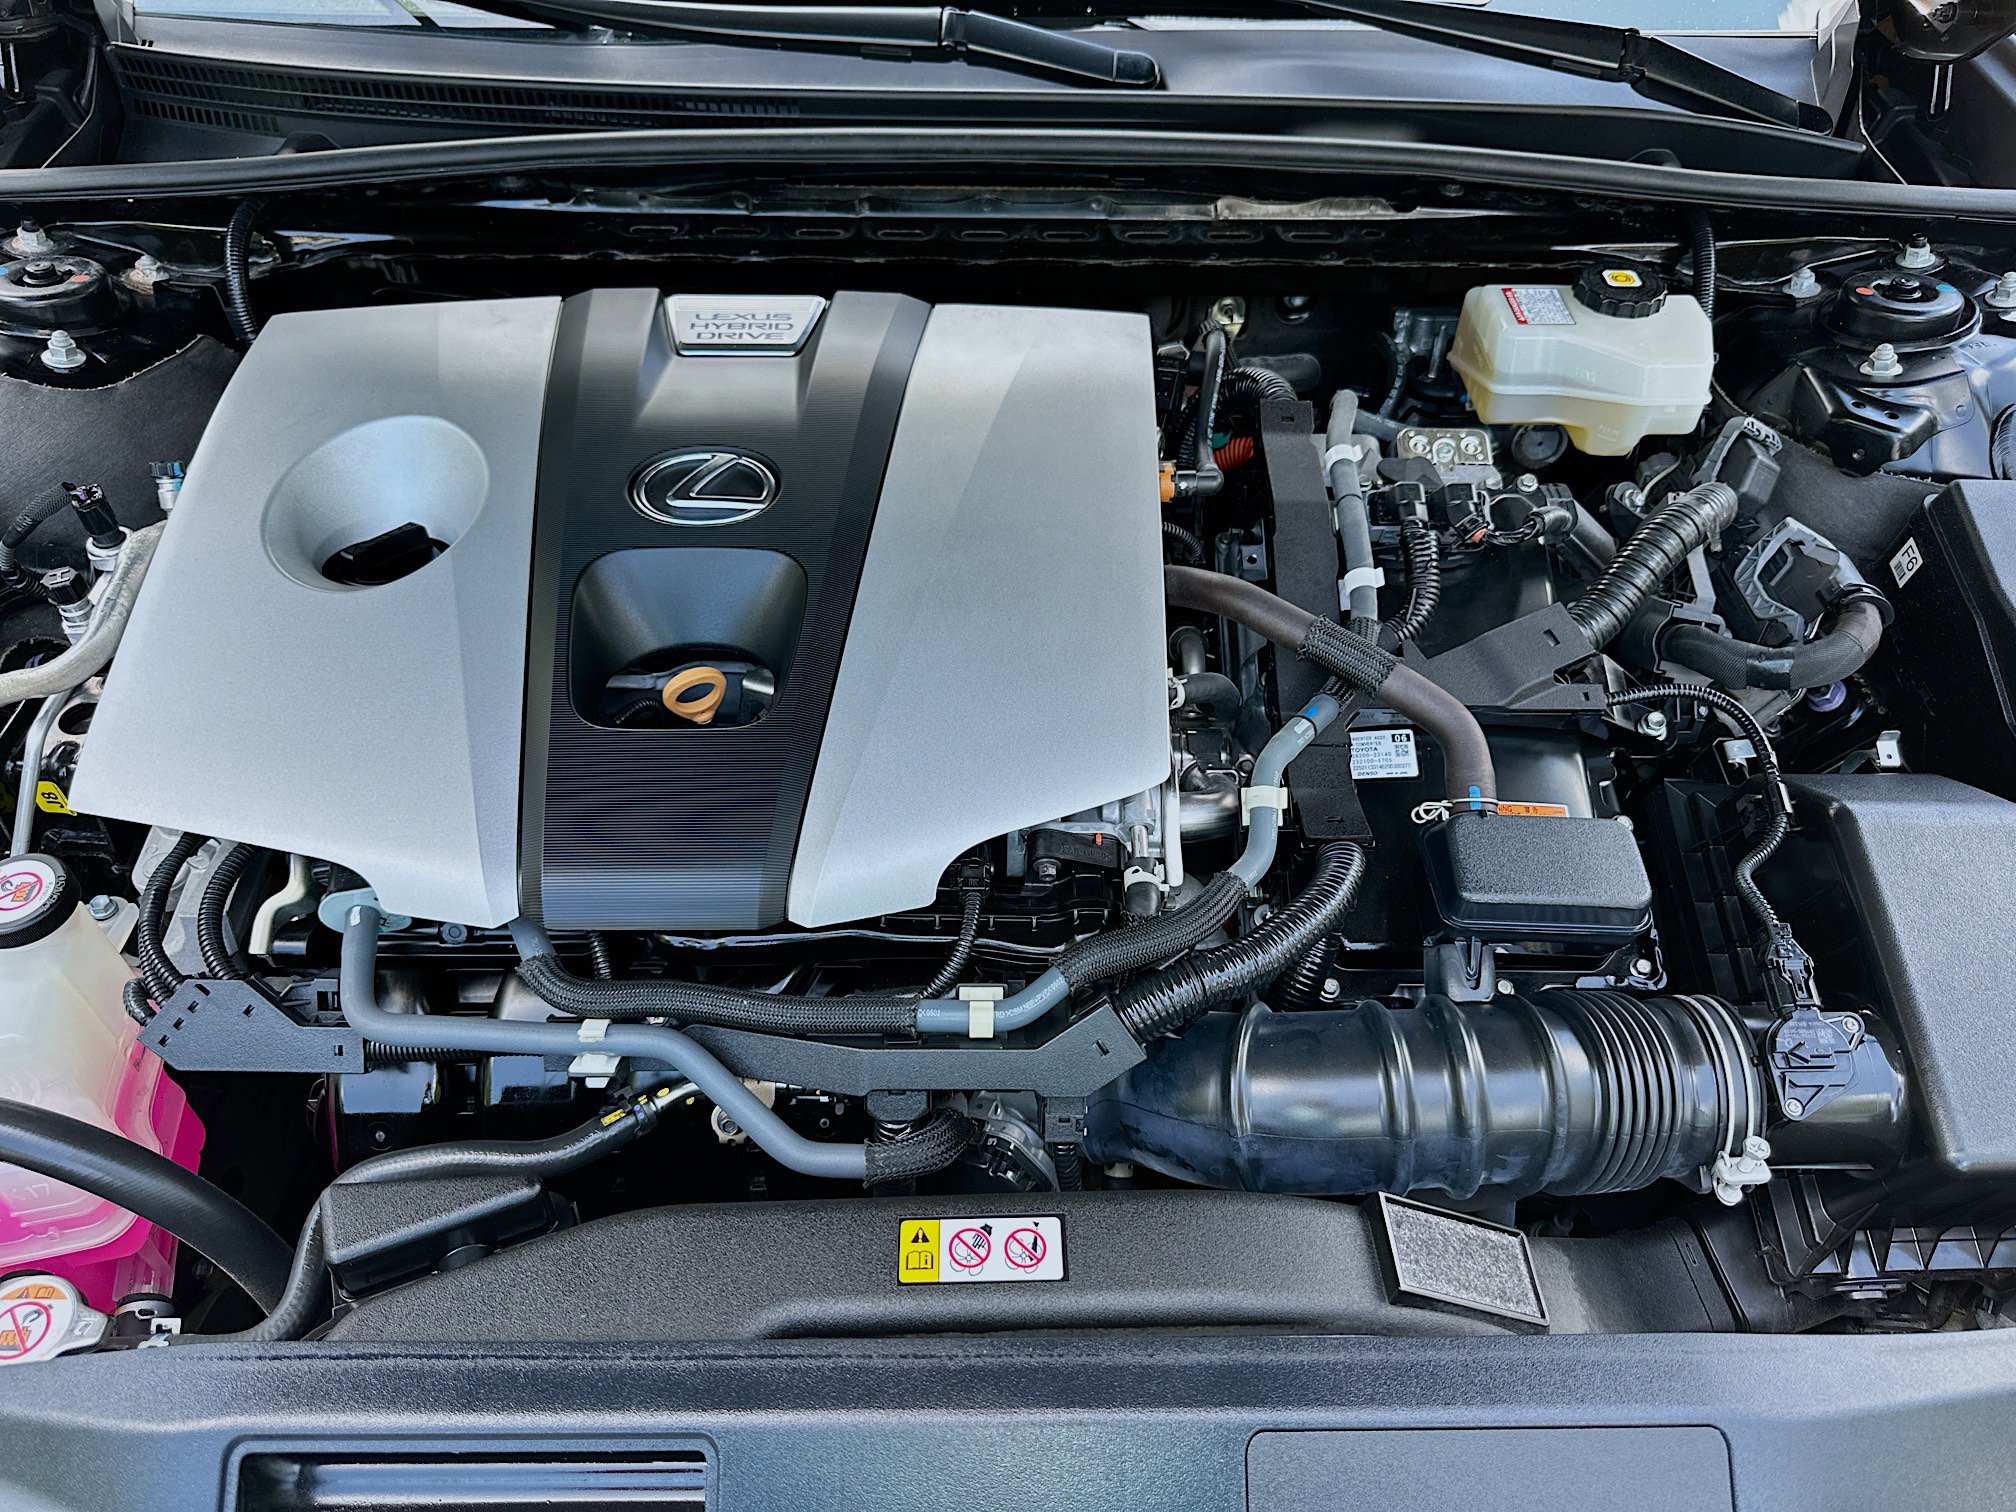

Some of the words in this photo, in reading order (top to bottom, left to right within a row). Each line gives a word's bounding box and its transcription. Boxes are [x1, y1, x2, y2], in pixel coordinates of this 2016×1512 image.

[695, 313, 792, 321] LEXUS
[690, 322, 794, 331] HYBRID
[696, 332, 785, 341] DRIVE
[1901, 544, 1918, 572] F6
[1395, 734, 1408, 742] 06
